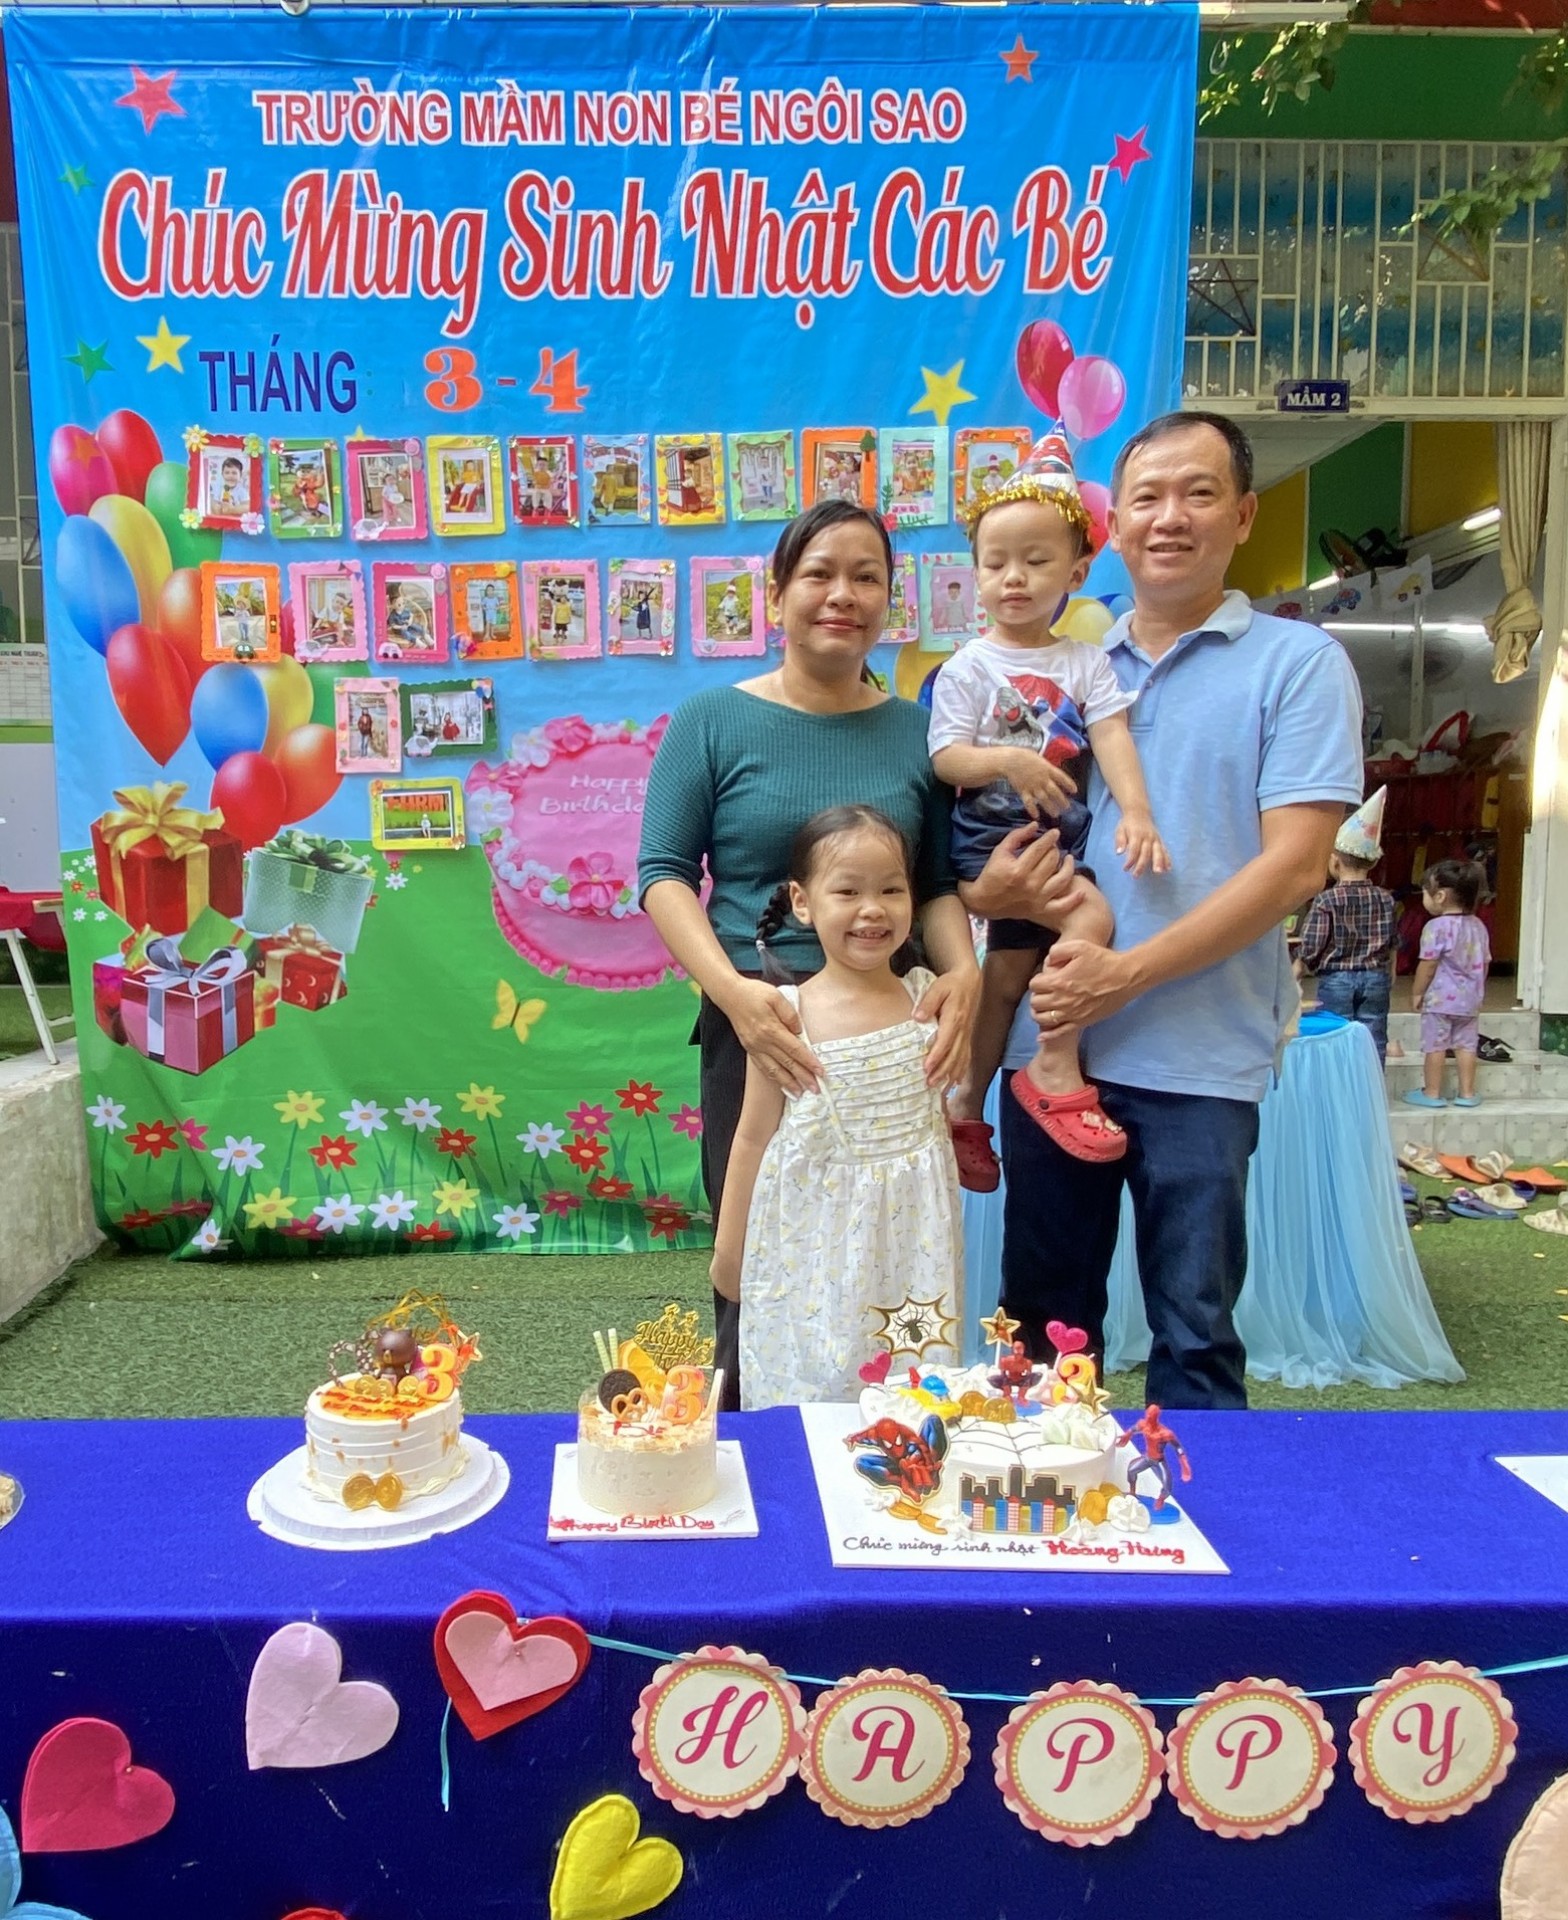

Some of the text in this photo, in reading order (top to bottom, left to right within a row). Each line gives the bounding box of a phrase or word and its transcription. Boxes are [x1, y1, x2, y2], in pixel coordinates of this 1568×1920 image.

[252, 76, 967, 146] TRƯỜNG MẦM NON BÉ NGÔI SAO
[98, 165, 1114, 338] Chúc Mừng Sinh Nhật Các Bé
[424, 346, 483, 412] 3
[529, 347, 592, 413] 4
[1286, 385, 1341, 407] MẦM 2
[539, 794, 645, 815] Birthda
[569, 774, 649, 797] Happy
[416, 1343, 458, 1401] 3
[663, 1364, 706, 1425] 3
